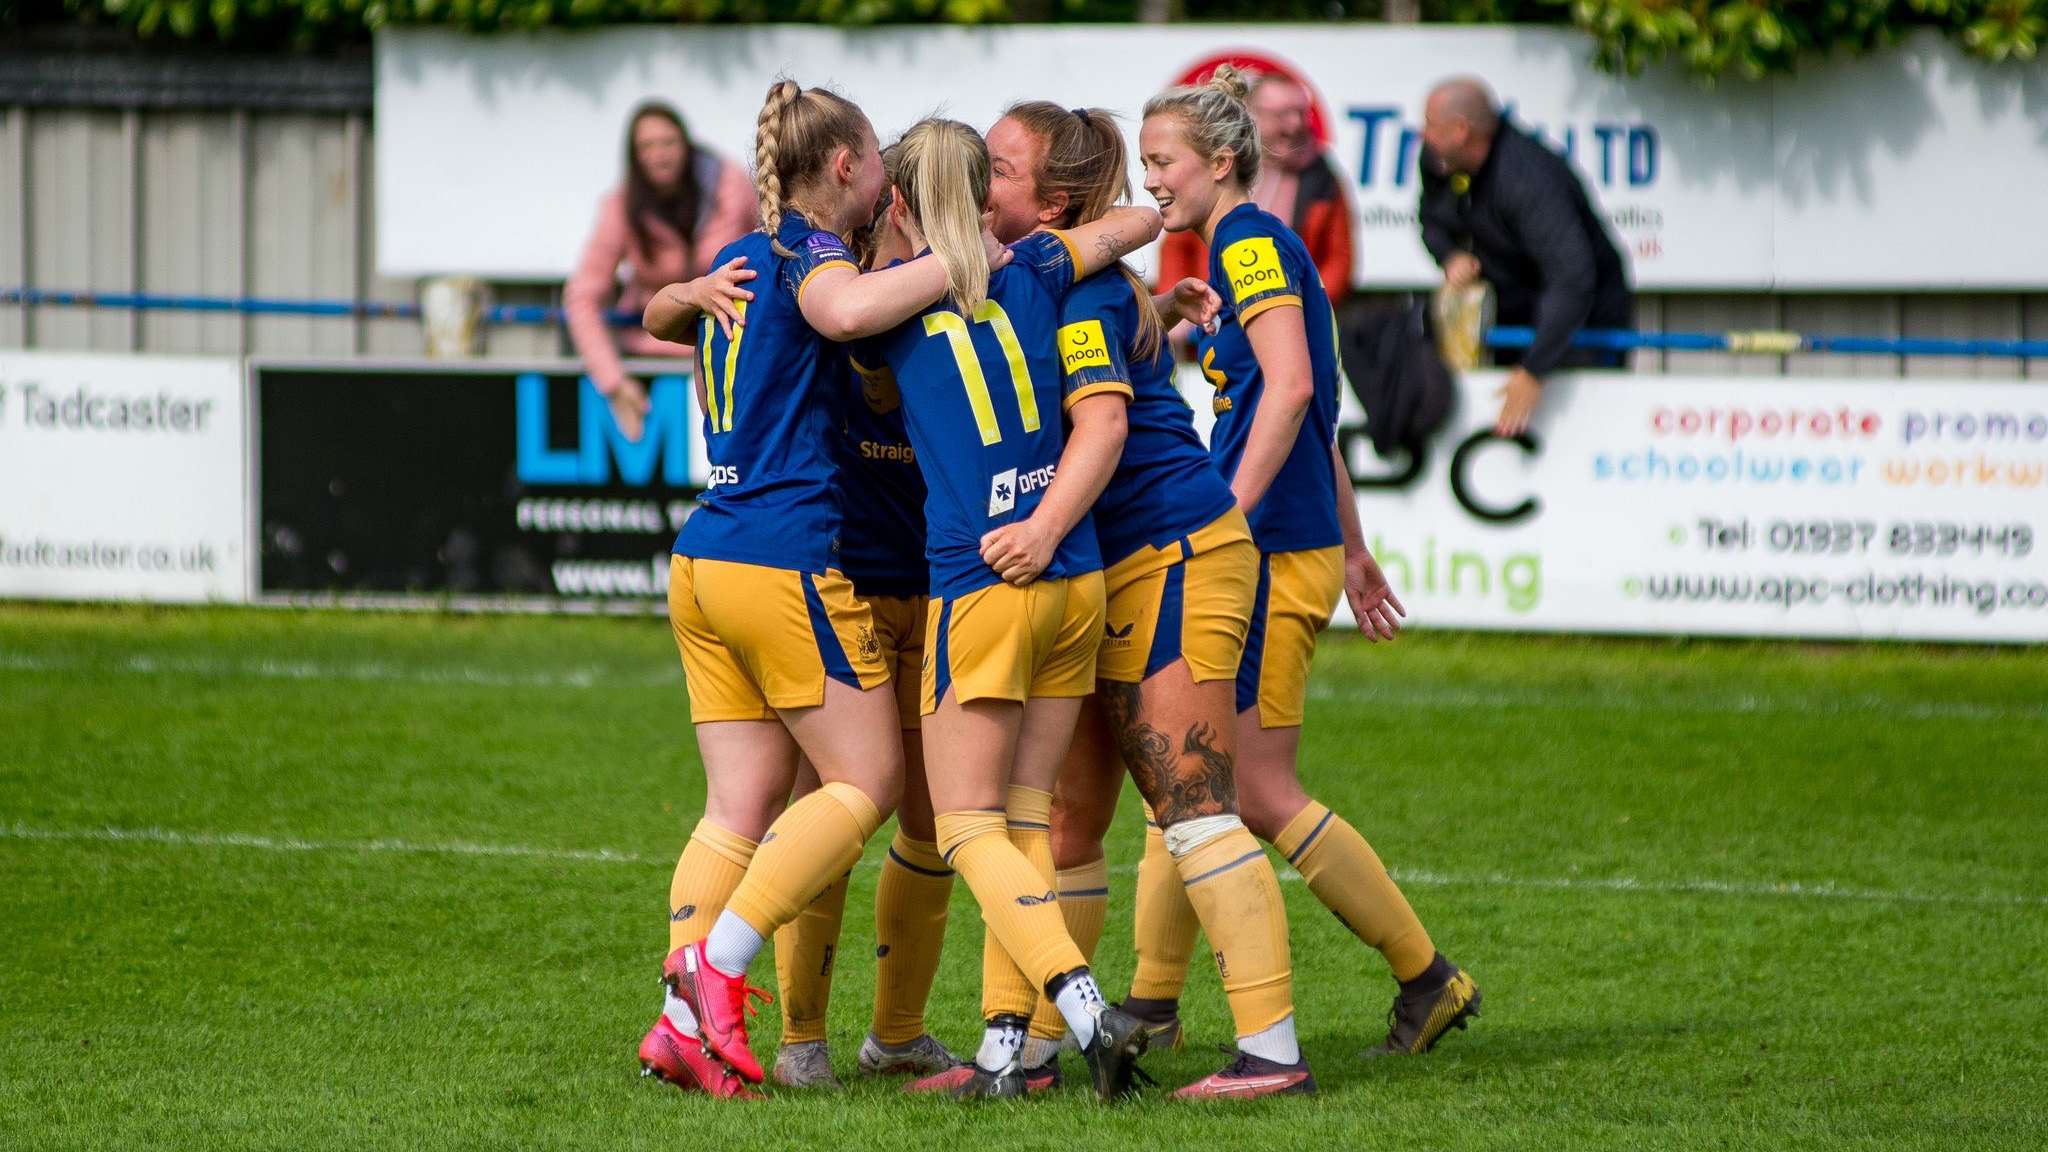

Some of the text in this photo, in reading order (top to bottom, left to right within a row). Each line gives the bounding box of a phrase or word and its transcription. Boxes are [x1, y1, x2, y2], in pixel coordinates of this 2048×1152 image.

[1234, 268, 1279, 293] noon
[922, 299, 1041, 446] 11
[1066, 348, 1105, 366] noon
[18, 382, 214, 431] Tadcaster
[1653, 407, 2048, 445] corporate promo
[860, 441, 914, 462] Straig
[1593, 447, 2045, 488] schoolwear workw
[1018, 464, 1057, 494] DFDS
[1769, 519, 1877, 554] 01937
